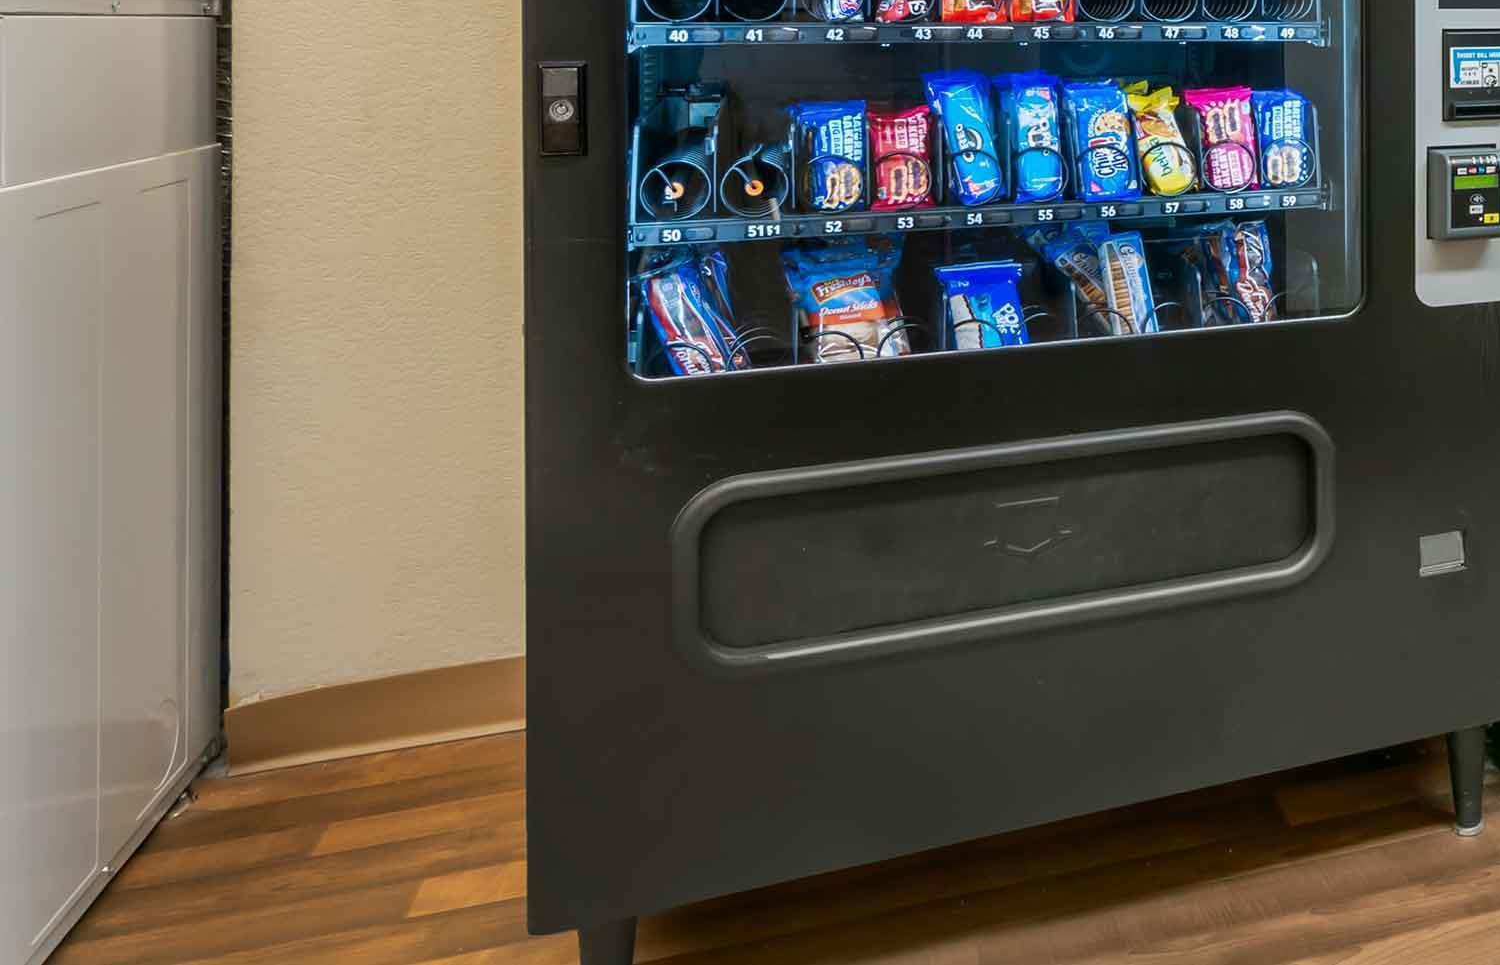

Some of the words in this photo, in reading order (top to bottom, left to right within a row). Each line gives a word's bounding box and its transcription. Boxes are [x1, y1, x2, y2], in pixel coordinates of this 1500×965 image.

[669, 29, 689, 43] 40
[745, 29, 764, 42] 41
[826, 28, 844, 41] 42
[915, 28, 932, 41] 43
[967, 27, 983, 40] 44
[1034, 27, 1050, 40] 45
[1099, 27, 1115, 40] 46
[1165, 27, 1180, 39] 47
[1224, 27, 1239, 39] 48
[1280, 27, 1295, 39] 49
[955, 122, 973, 163] OREO
[1165, 202, 1180, 213] 57
[1229, 198, 1244, 209] 58
[1282, 195, 1296, 207] 59
[1038, 209, 1053, 221] 55
[1101, 206, 1116, 218] 56
[897, 217, 914, 229] 53
[967, 213, 982, 225] 54
[748, 225, 765, 238] 51
[825, 221, 843, 234] 52
[662, 229, 681, 243] 50
